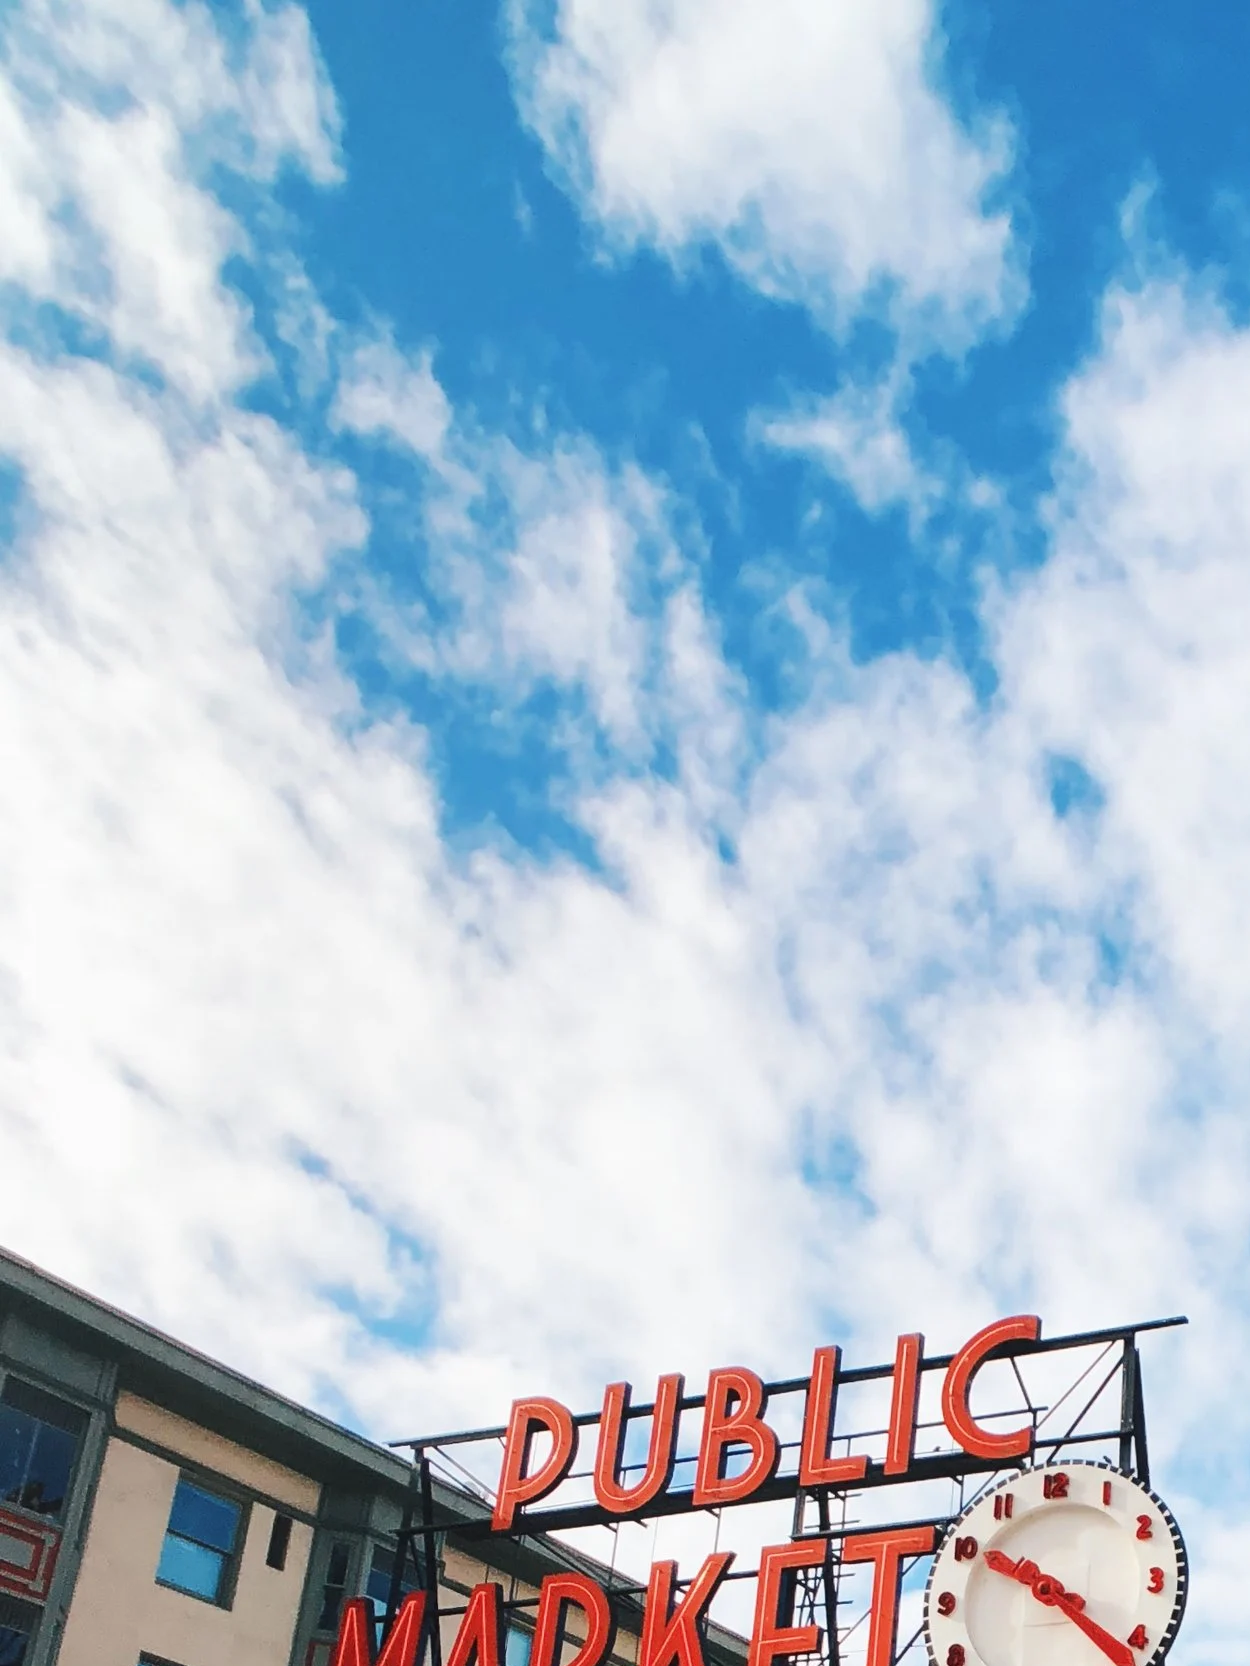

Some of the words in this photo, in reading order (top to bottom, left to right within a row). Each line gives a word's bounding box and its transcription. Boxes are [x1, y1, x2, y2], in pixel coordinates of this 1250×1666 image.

[491, 1314, 1042, 1531] PUBLIC
[1043, 1472, 1070, 1499] 12
[1103, 1481, 1111, 1506] 1
[993, 1493, 1014, 1520] 11
[1136, 1515, 1153, 1540] 2
[954, 1536, 978, 1562] 10
[1147, 1567, 1165, 1593] 3
[938, 1592, 956, 1616] 9
[1127, 1624, 1149, 1650] 4
